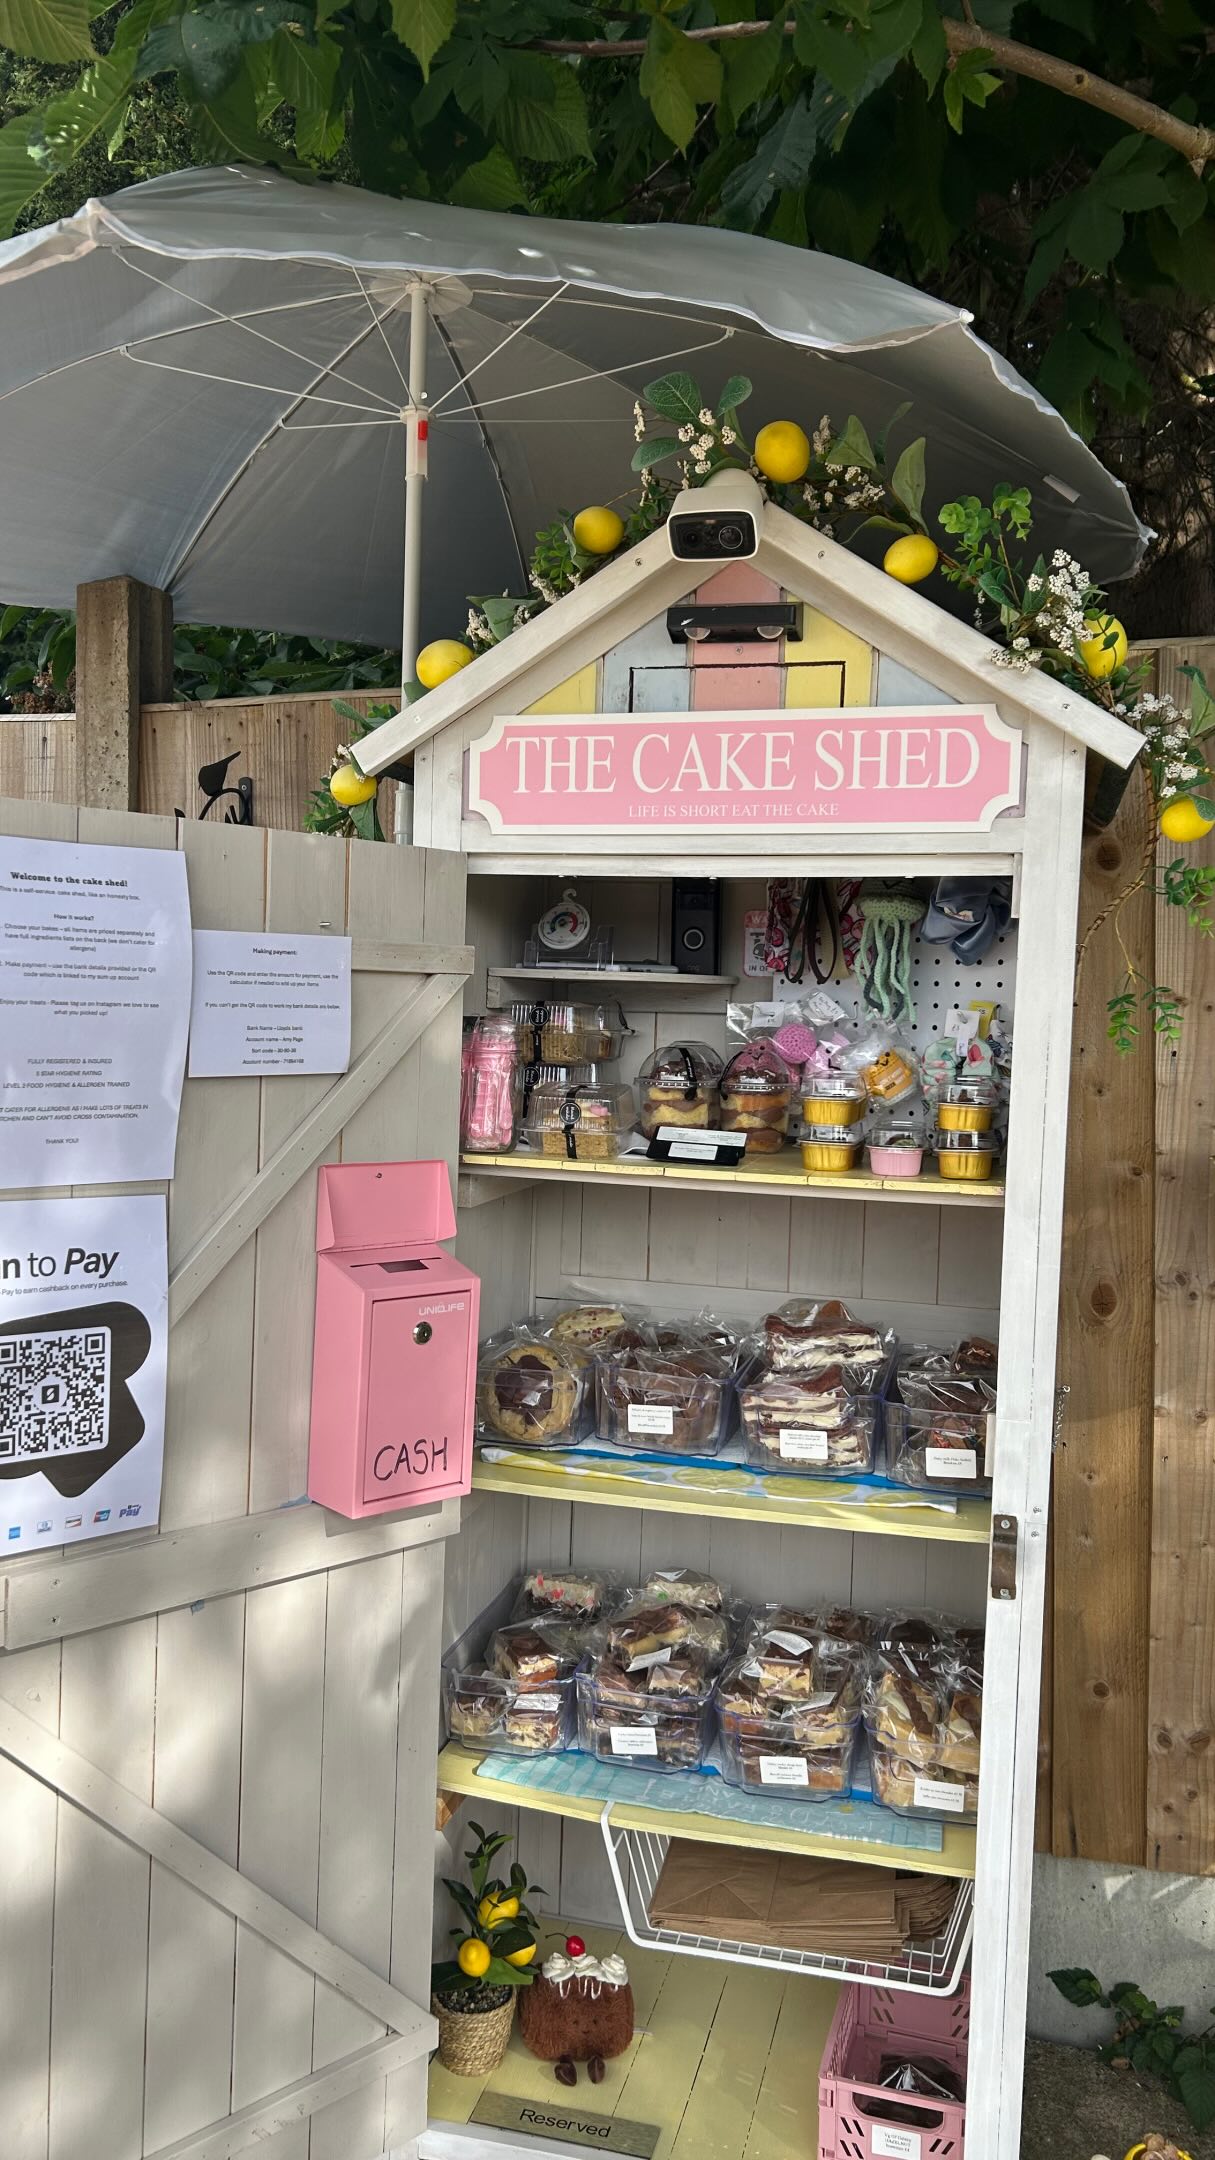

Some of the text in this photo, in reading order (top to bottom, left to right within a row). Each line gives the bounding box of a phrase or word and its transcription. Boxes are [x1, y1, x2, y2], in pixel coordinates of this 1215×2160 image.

[505, 727, 980, 794] THE CAKE SHED
[628, 802, 840, 818] LIFE IS SHORT EAT THE CAKE
[10, 871, 128, 888] Welcome to the cake shed!
[27, 1252, 57, 1278] to
[64, 1247, 120, 1279] Pay
[14, 1288, 22, 1296] to
[22, 1286, 38, 1294] earn
[39, 1284, 70, 1293] cashback
[70, 1283, 80, 1291] on
[80, 1282, 98, 1290] every
[373, 1436, 448, 1482] CASH
[518, 2108, 612, 2139] Reserved
